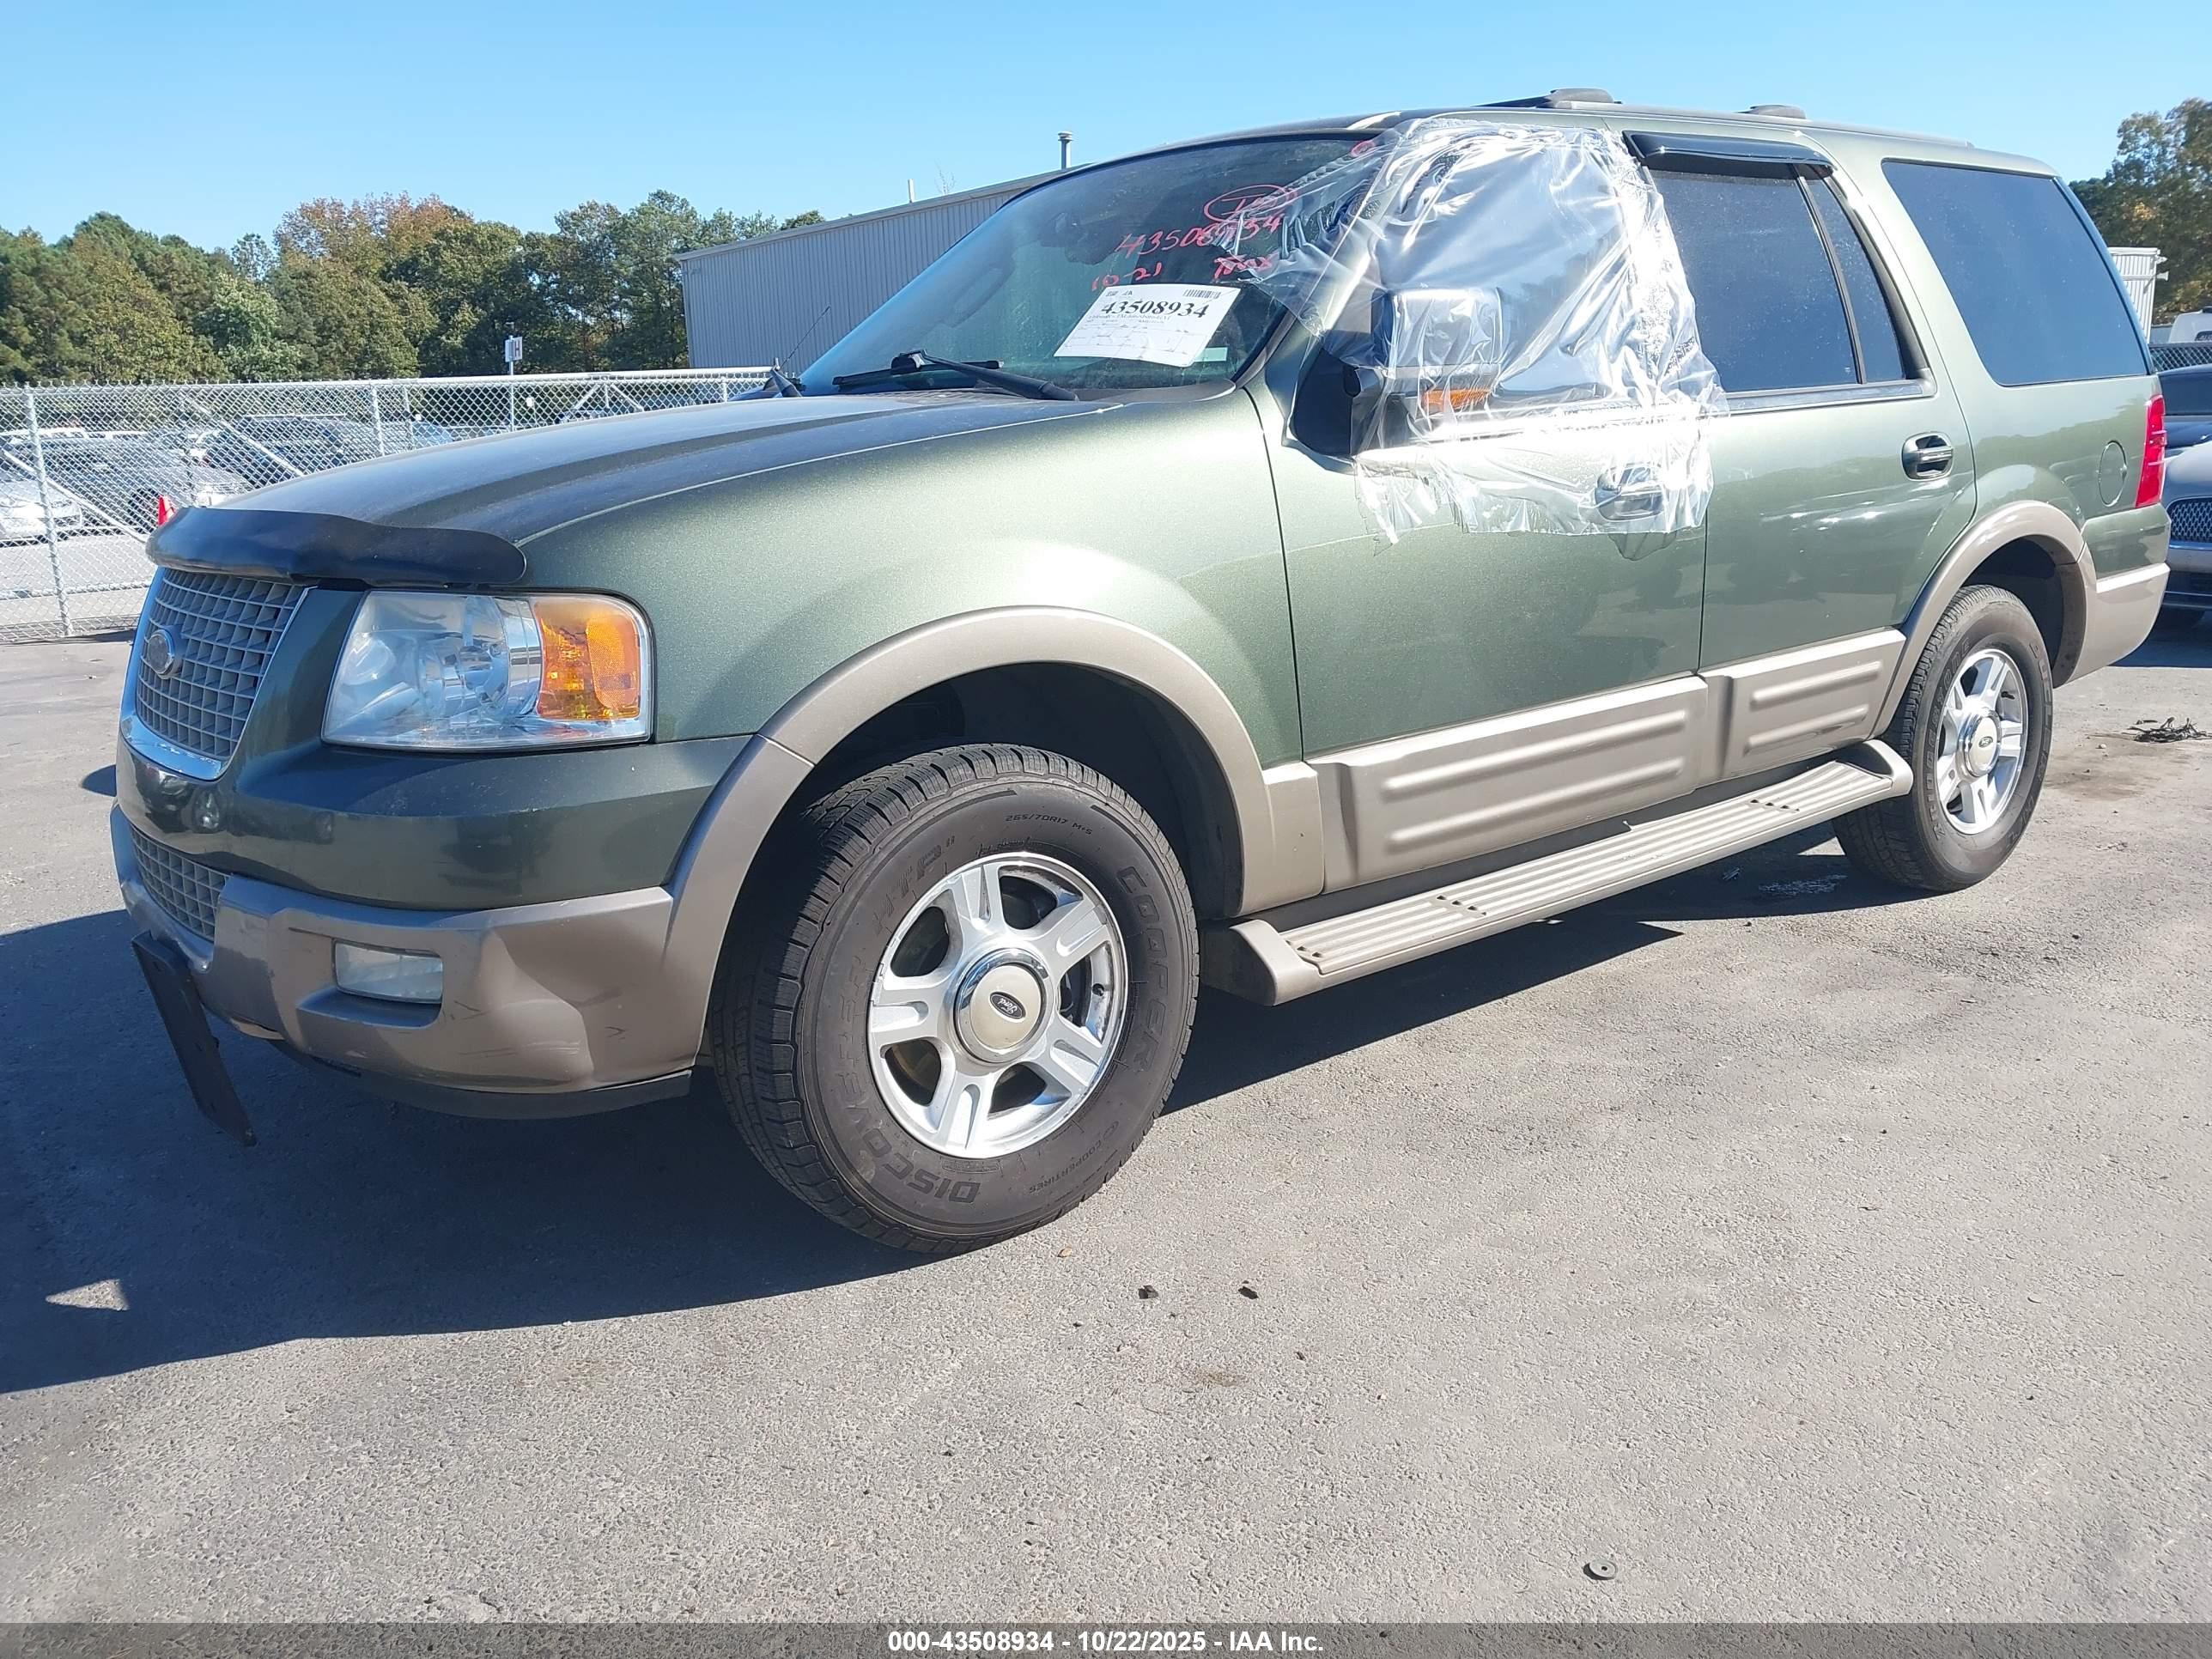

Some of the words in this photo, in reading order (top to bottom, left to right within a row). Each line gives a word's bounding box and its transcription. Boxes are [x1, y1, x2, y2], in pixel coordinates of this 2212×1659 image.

[1101, 299, 1210, 319] 43508934
[1006, 813, 1068, 824] 265/70R17
[1072, 822, 1093, 836] M+S
[1117, 865, 1170, 1073] COOPER
[997, 997, 1018, 1015] Ford
